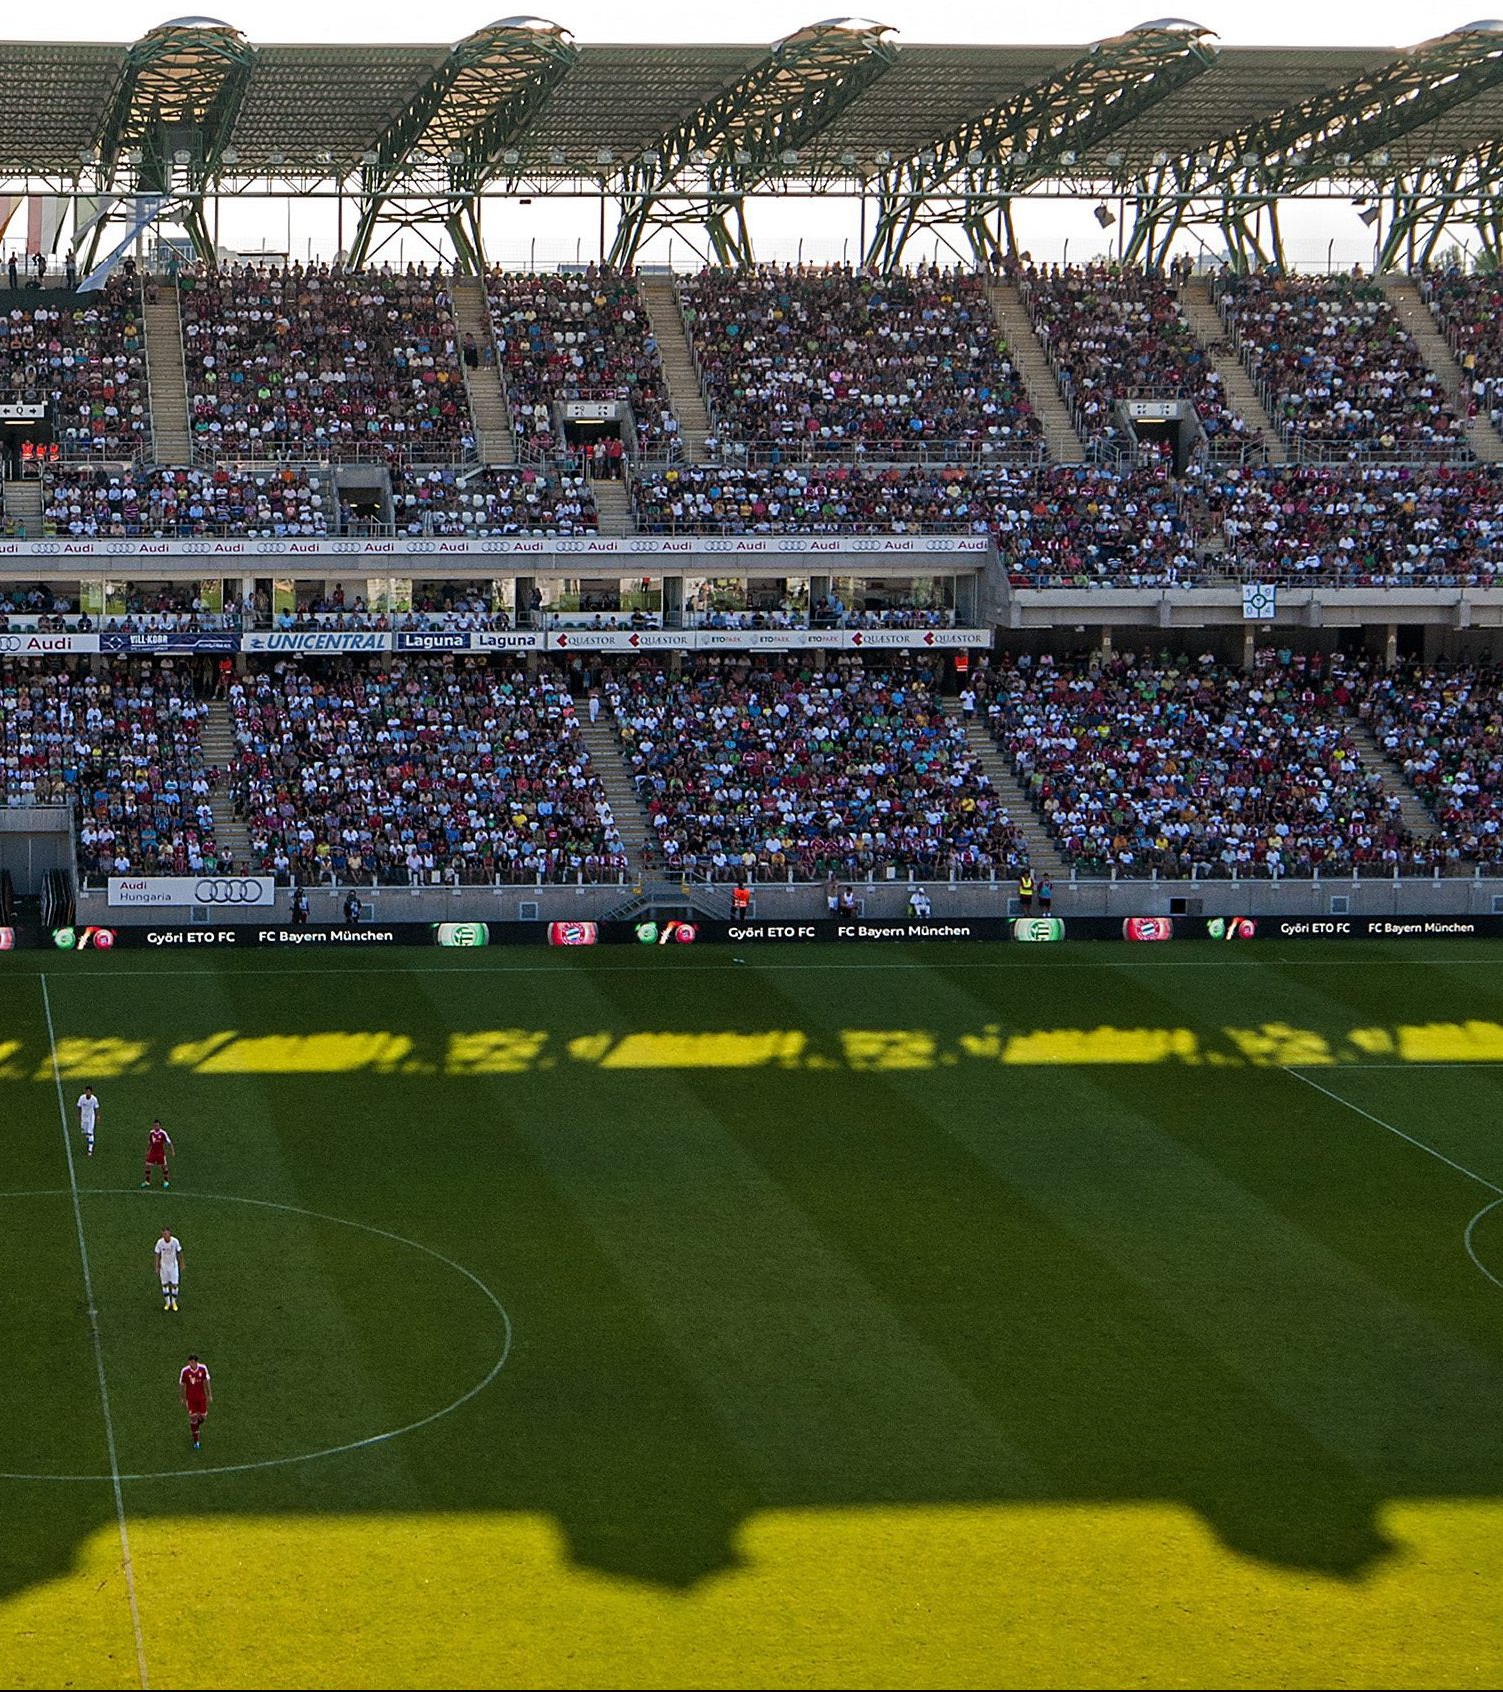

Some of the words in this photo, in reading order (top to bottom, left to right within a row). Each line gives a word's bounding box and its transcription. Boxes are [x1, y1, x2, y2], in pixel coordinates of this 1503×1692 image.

[16, 406, 24, 416] Q
[63, 544, 94, 554] Audi
[138, 543, 169, 553] Audi
[214, 543, 244, 553] Audi
[289, 543, 320, 553] Audi
[364, 543, 394, 553] Audi
[439, 542, 469, 552] Audi
[513, 542, 544, 552] Audi
[587, 542, 618, 552] Audi
[662, 542, 692, 552] Audi
[736, 541, 766, 551] Audi
[810, 541, 840, 551] Audi
[884, 541, 914, 551] Audi
[957, 541, 988, 551] Audi
[27, 637, 72, 650] Audi
[267, 634, 386, 649] UNICENTRAL
[405, 634, 463, 649] Laguna
[479, 634, 536, 649] Laguna
[120, 881, 147, 890] Audi
[119, 892, 172, 902] Hungaria
[728, 926, 764, 940] Győri
[767, 926, 796, 938] ETO
[798, 926, 816, 938] FC
[838, 926, 855, 937] FC
[858, 926, 905, 939] Bayern
[908, 925, 971, 937] München
[1311, 922, 1335, 934] ETO
[1336, 922, 1351, 934] FC
[1368, 922, 1383, 933] FC
[1384, 922, 1422, 935] Bayern
[1424, 921, 1475, 933] München
[146, 932, 183, 946] Győri
[186, 931, 215, 943] ETO
[218, 931, 236, 943] FC
[258, 930, 276, 942] FC
[279, 931, 327, 944] Bayern
[330, 930, 393, 942] München
